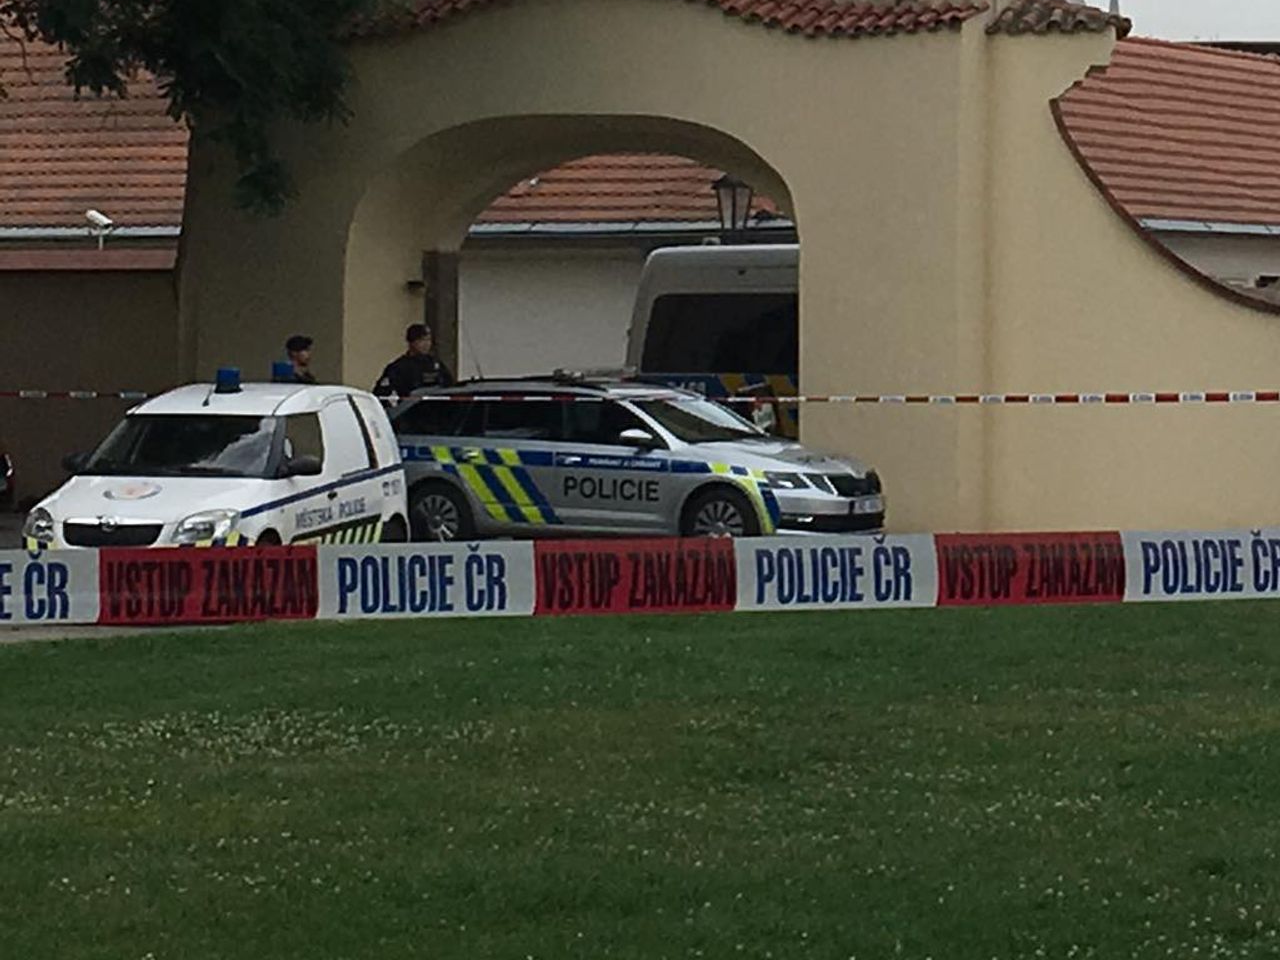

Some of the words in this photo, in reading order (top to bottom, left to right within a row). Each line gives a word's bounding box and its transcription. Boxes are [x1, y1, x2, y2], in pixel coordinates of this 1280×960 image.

[563, 475, 660, 501] POLICIE
[24, 549, 70, 620] ČR
[107, 560, 194, 619] VSTUP
[337, 553, 455, 614] POLICIE
[465, 543, 507, 612] ČR
[541, 551, 619, 609] VSTUP
[755, 547, 864, 605] POLICIE
[873, 537, 913, 602] ČR
[943, 543, 1017, 599] VSTUP
[1140, 538, 1244, 595] POLICIE
